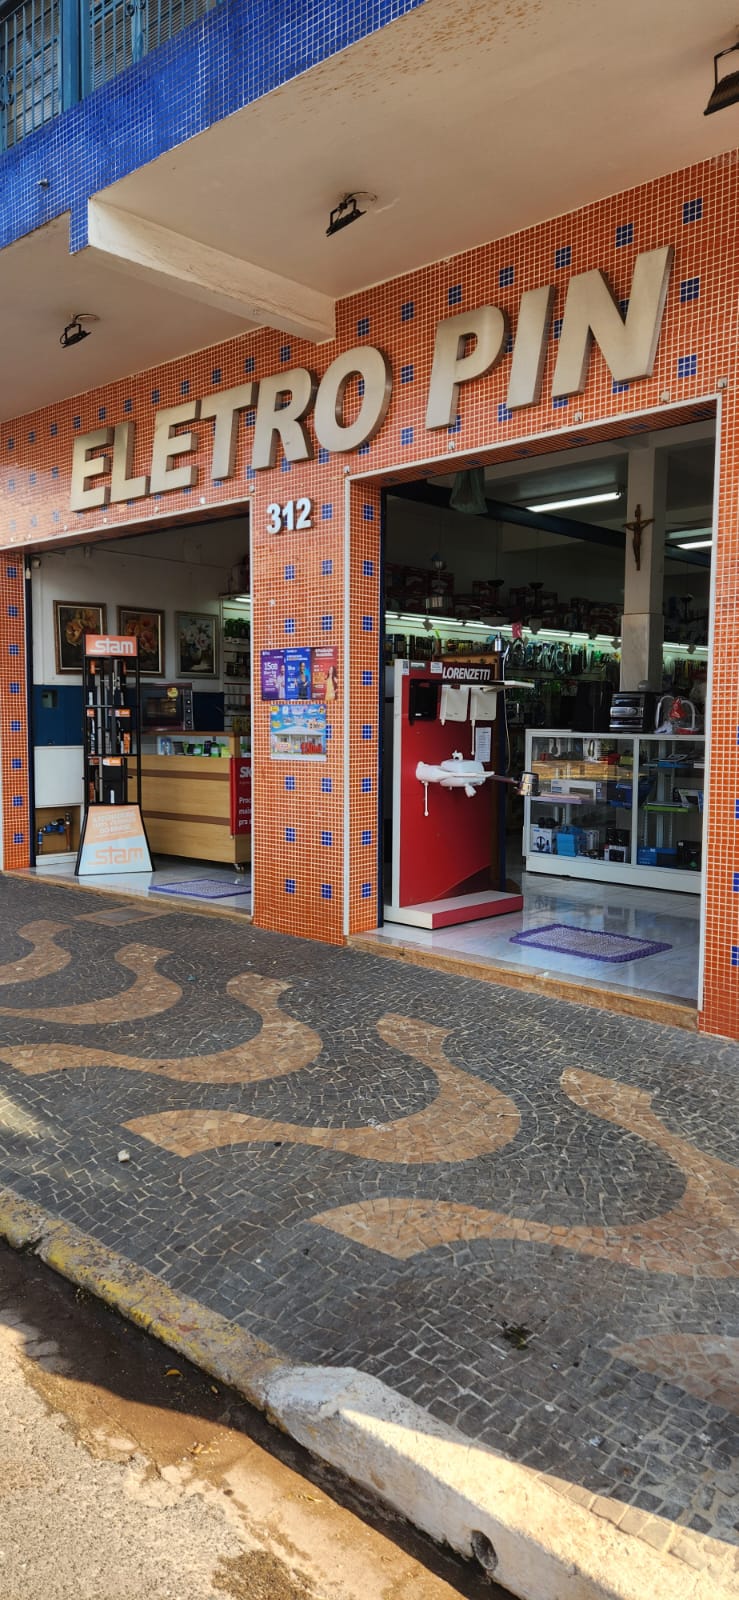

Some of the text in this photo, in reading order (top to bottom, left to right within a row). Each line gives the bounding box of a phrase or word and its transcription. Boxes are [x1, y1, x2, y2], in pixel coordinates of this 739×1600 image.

[70, 245, 675, 513] ELETRO PIN
[266, 497, 312, 535] 312
[90, 638, 134, 655] stam
[442, 666, 491, 680] LORENZETTI
[87, 846, 144, 866] stam
